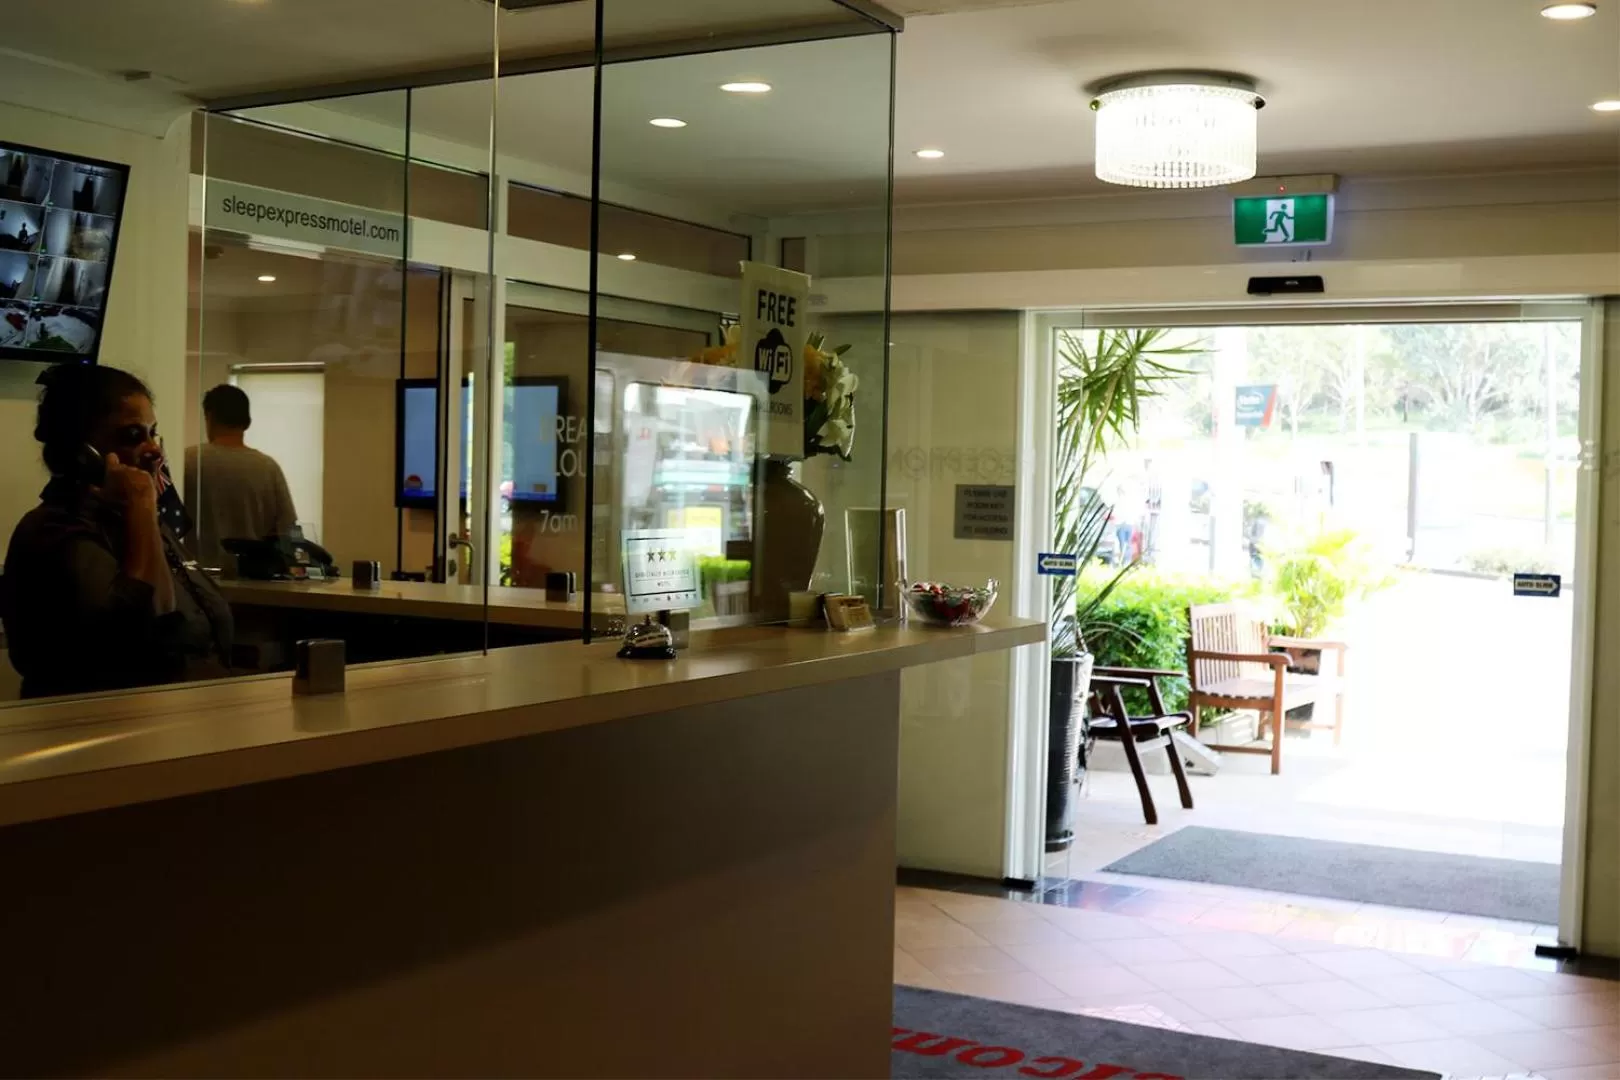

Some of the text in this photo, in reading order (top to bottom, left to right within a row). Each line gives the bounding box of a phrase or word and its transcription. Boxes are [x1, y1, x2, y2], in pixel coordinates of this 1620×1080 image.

[222, 195, 399, 242] sleepexpressmotel.com
[757, 289, 796, 327] FREE
[541, 415, 587, 443] REA
[540, 509, 578, 533] 7am
